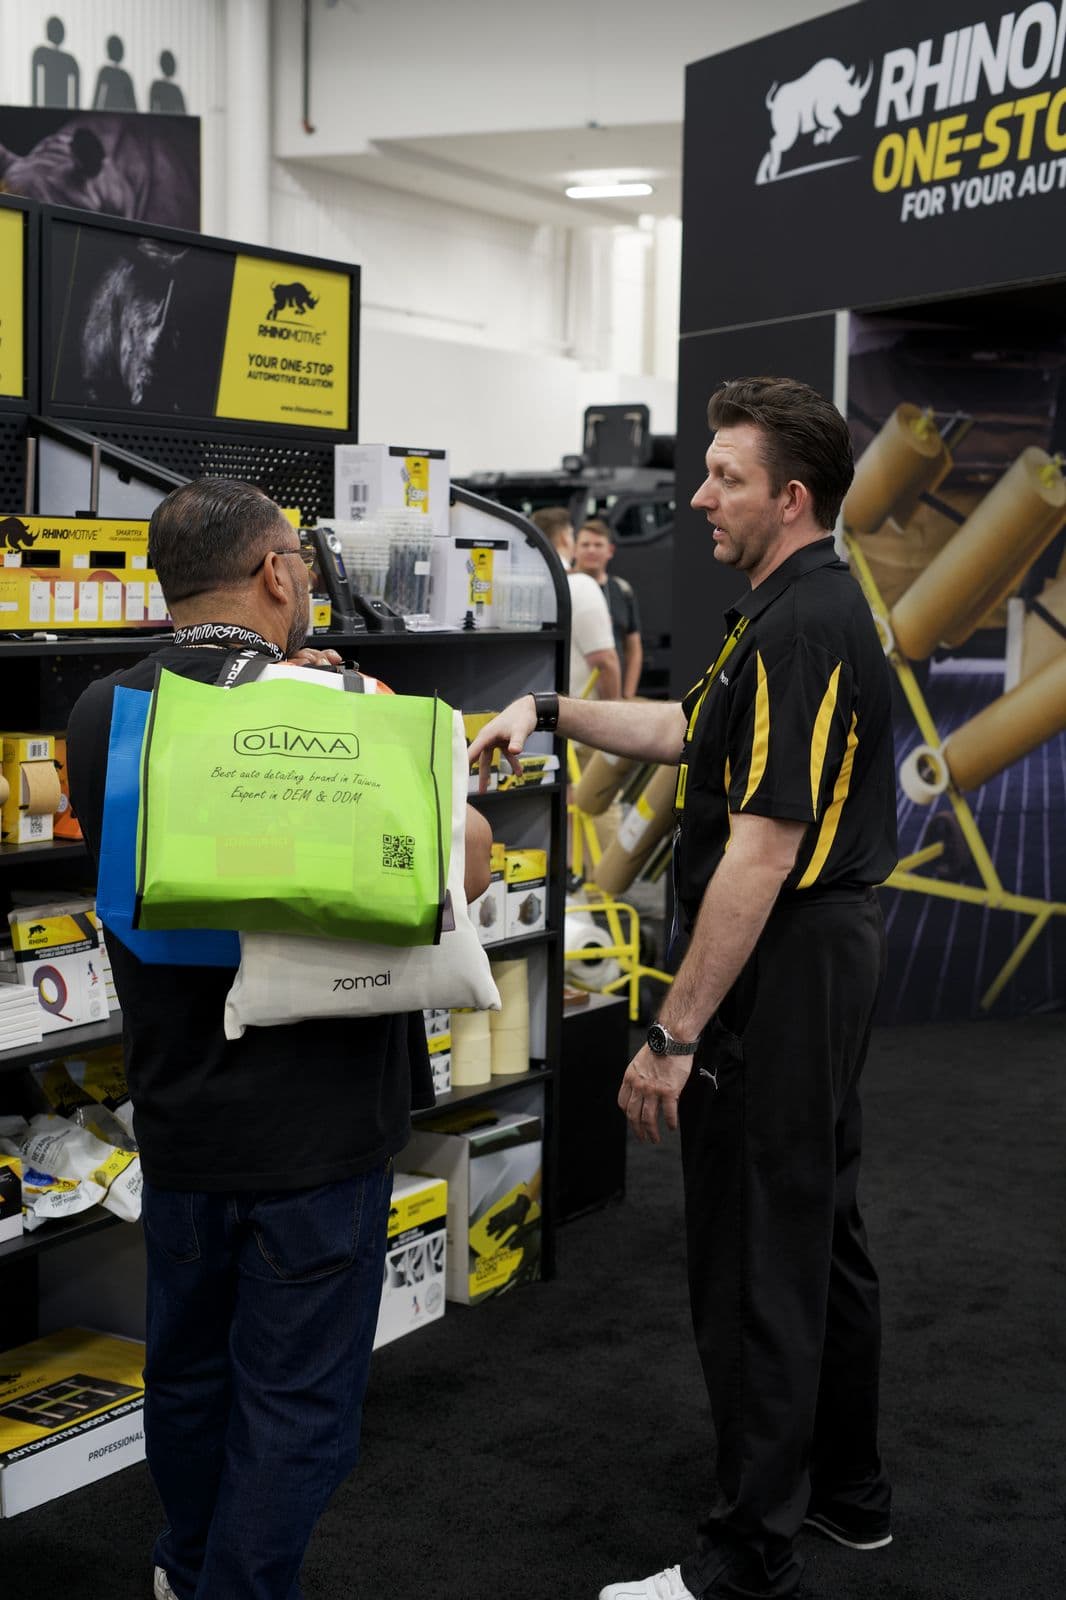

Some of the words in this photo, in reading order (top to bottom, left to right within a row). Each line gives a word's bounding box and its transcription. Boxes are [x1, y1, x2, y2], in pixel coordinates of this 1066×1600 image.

[900, 186, 947, 223] FOR
[949, 169, 1014, 212] YOUR
[248, 353, 278, 369] YOUR
[280, 358, 334, 376] ONE-STOP
[247, 370, 297, 385] AUTOMOTIVE
[298, 377, 334, 389] SOLUTION
[41, 528, 98, 541] RHINOMOTIVE
[243, 731, 352, 754] OLIMA
[210, 766, 237, 779] Best
[240, 770, 260, 778] auto
[264, 769, 304, 785] detailing
[309, 771, 336, 783] brand
[340, 774, 348, 783] in
[351, 773, 382, 789] Taiwan
[231, 785, 266, 802] Expert
[269, 790, 278, 800] in
[282, 788, 312, 801] OEM
[316, 790, 327, 802] &
[332, 790, 362, 804] ODM
[7, 1426, 82, 1460] AUTOMOTIVE
[79, 1414, 111, 1429] BODY
[88, 1431, 144, 1462] PROFESSIONAL
